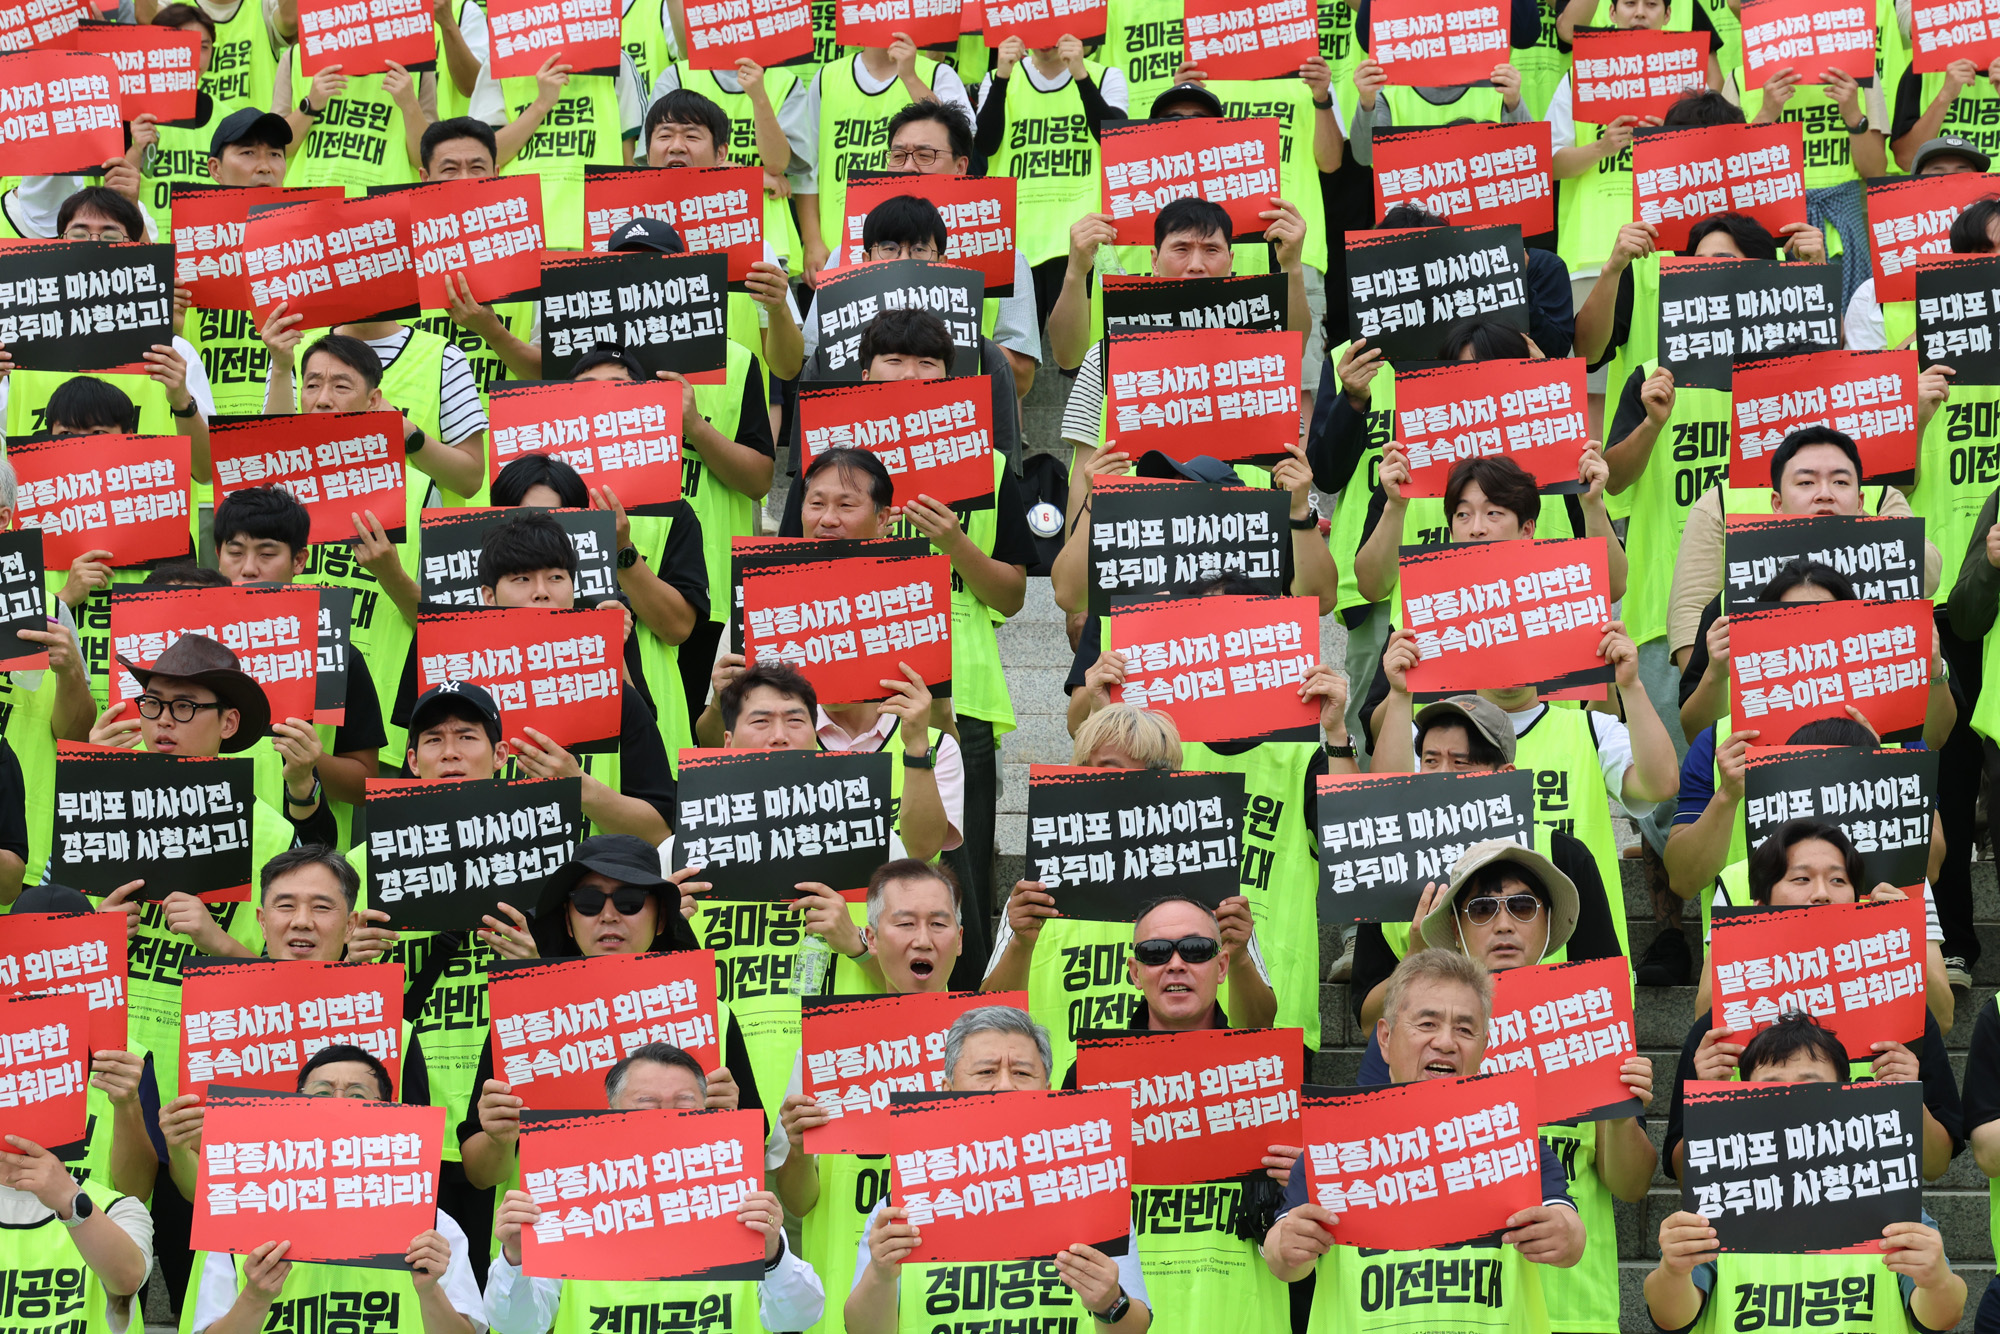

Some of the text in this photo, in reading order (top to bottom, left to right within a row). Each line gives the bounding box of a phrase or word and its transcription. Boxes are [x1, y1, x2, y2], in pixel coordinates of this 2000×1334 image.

[301, 1, 368, 33] 말종사자
[306, 12, 432, 56] 졸속이전 멈춰라!
[491, 3, 560, 36] 말종사자
[692, 5, 810, 49] 졸속이전 멈춰라!
[842, 0, 910, 25] 졸속이전
[986, 5, 1049, 27] 졸속이전
[1186, 0, 1307, 37] 말종사자 외면한
[1373, 6, 1499, 41] 말종사자 외면한
[1744, 7, 1865, 48] 말종사자 외면한
[1919, 21, 1987, 52] 졸속이전
[495, 18, 620, 58] 졸속이전 멈춰라!
[1190, 19, 1317, 60] 졸속이전 멈춰라!
[1376, 29, 1508, 64] 졸속이전 멈춰라!
[1748, 29, 1874, 69] 졸속이전 멈춰라!
[1575, 48, 1698, 79] 말종사자 외면한
[47, 75, 110, 103] 외면한
[308, 131, 386, 165] 이전반대
[1011, 115, 1088, 149] 경마공원
[1010, 150, 1091, 179] 이전반대
[1105, 139, 1264, 190] 말종사자 외면한
[1379, 144, 1536, 197] 말종사자 외면한
[1636, 144, 1790, 197] 말종사자 외면한
[680, 189, 748, 222] 외면한
[1474, 172, 1550, 209] 멈춰라!
[1639, 172, 1803, 224] 졸속이전 멈춰라!
[245, 218, 396, 276] 말종사자 외면한
[0, 264, 165, 309] 무대포 마사이전,
[250, 246, 413, 306] 졸속이전 멈춰라!
[1351, 245, 1518, 302] 무대포 마사이전,
[545, 274, 719, 322] 무대포 마사이전,
[1357, 278, 1525, 337] 경주마 사형선고!
[1662, 284, 1833, 327] 무대포 마사이전,
[0, 298, 169, 347] 경주마 사형선고!
[1665, 328, 1734, 362] 경주마
[1112, 354, 1285, 400] 말종사자 외면한
[904, 400, 976, 437] 외면한
[1116, 385, 1297, 432] 졸속이전 멈춰라!
[1400, 382, 1571, 437] 말종사자 외면한
[1736, 374, 1902, 430] 말종사자 외면한
[493, 405, 666, 456] 말종사자 외면한
[597, 435, 679, 471] 멈춰라!
[1406, 412, 1586, 469] 졸속이전 멈춰라!
[216, 433, 388, 484] 말종사자 외면한
[110, 490, 187, 525] 멈춰라!
[1093, 511, 1278, 551] 무대포 마사이전,
[749, 581, 933, 639] 말종사자 외면한
[1406, 563, 1592, 627] 말종사자 외면한
[222, 616, 300, 651] 외면한
[861, 613, 948, 656] 멈춰라!
[1413, 595, 1609, 661] 졸속이전 멈춰라!
[422, 635, 605, 685] 말종사자 외면한
[1734, 625, 1916, 684] 말종사자 외면한
[1121, 667, 1225, 708] 졸속이전
[1741, 657, 1927, 718] 졸속이전 멈춰라!
[58, 782, 243, 823] 무대포 마사이전,
[680, 776, 881, 831] 무대포 마사이전,
[1032, 796, 1233, 848] 무대포 마사이전,
[1322, 794, 1524, 853] 무대포 마사이전,
[1748, 774, 1928, 829] 무대포 마사이전,
[60, 819, 248, 863] 경주마 사형선고!
[371, 802, 571, 862] 무대포 마사이전,
[683, 815, 885, 867] 경주마 사형선고!
[376, 862, 456, 902] 경주마
[1035, 835, 1237, 888] 경주마 사형선고!
[1716, 928, 1910, 995] 말종사자 외면한
[1529, 987, 1613, 1034] 외면한
[1839, 962, 1923, 1011] 멈춰라!
[185, 1002, 294, 1045] 말종사자
[298, 991, 383, 1030] 외면한
[495, 979, 698, 1049] 말종사자 외면한
[187, 1039, 298, 1083] 졸속이전
[1199, 1055, 1283, 1096] 외면한
[206, 1133, 422, 1176] 말종사자 외면한
[896, 1119, 1111, 1187] 말종사자 외면한
[1309, 1102, 1520, 1176] 말종사자 외면한
[1688, 1109, 1913, 1174] 무대포 마사이전,
[207, 1171, 433, 1216] 졸속이전 멈춰라!
[525, 1139, 743, 1204] 말종사자 외면한
[902, 1156, 1128, 1226] 졸속이전 멈춰라!
[1316, 1138, 1537, 1212] 졸속이전 멈춰라!
[1693, 1153, 1918, 1218] 경주마 사형선고!
[926, 1261, 1072, 1315] 경마공원
[1361, 1260, 1502, 1312] 이전반대
[1735, 1274, 1875, 1334] 경마공원
